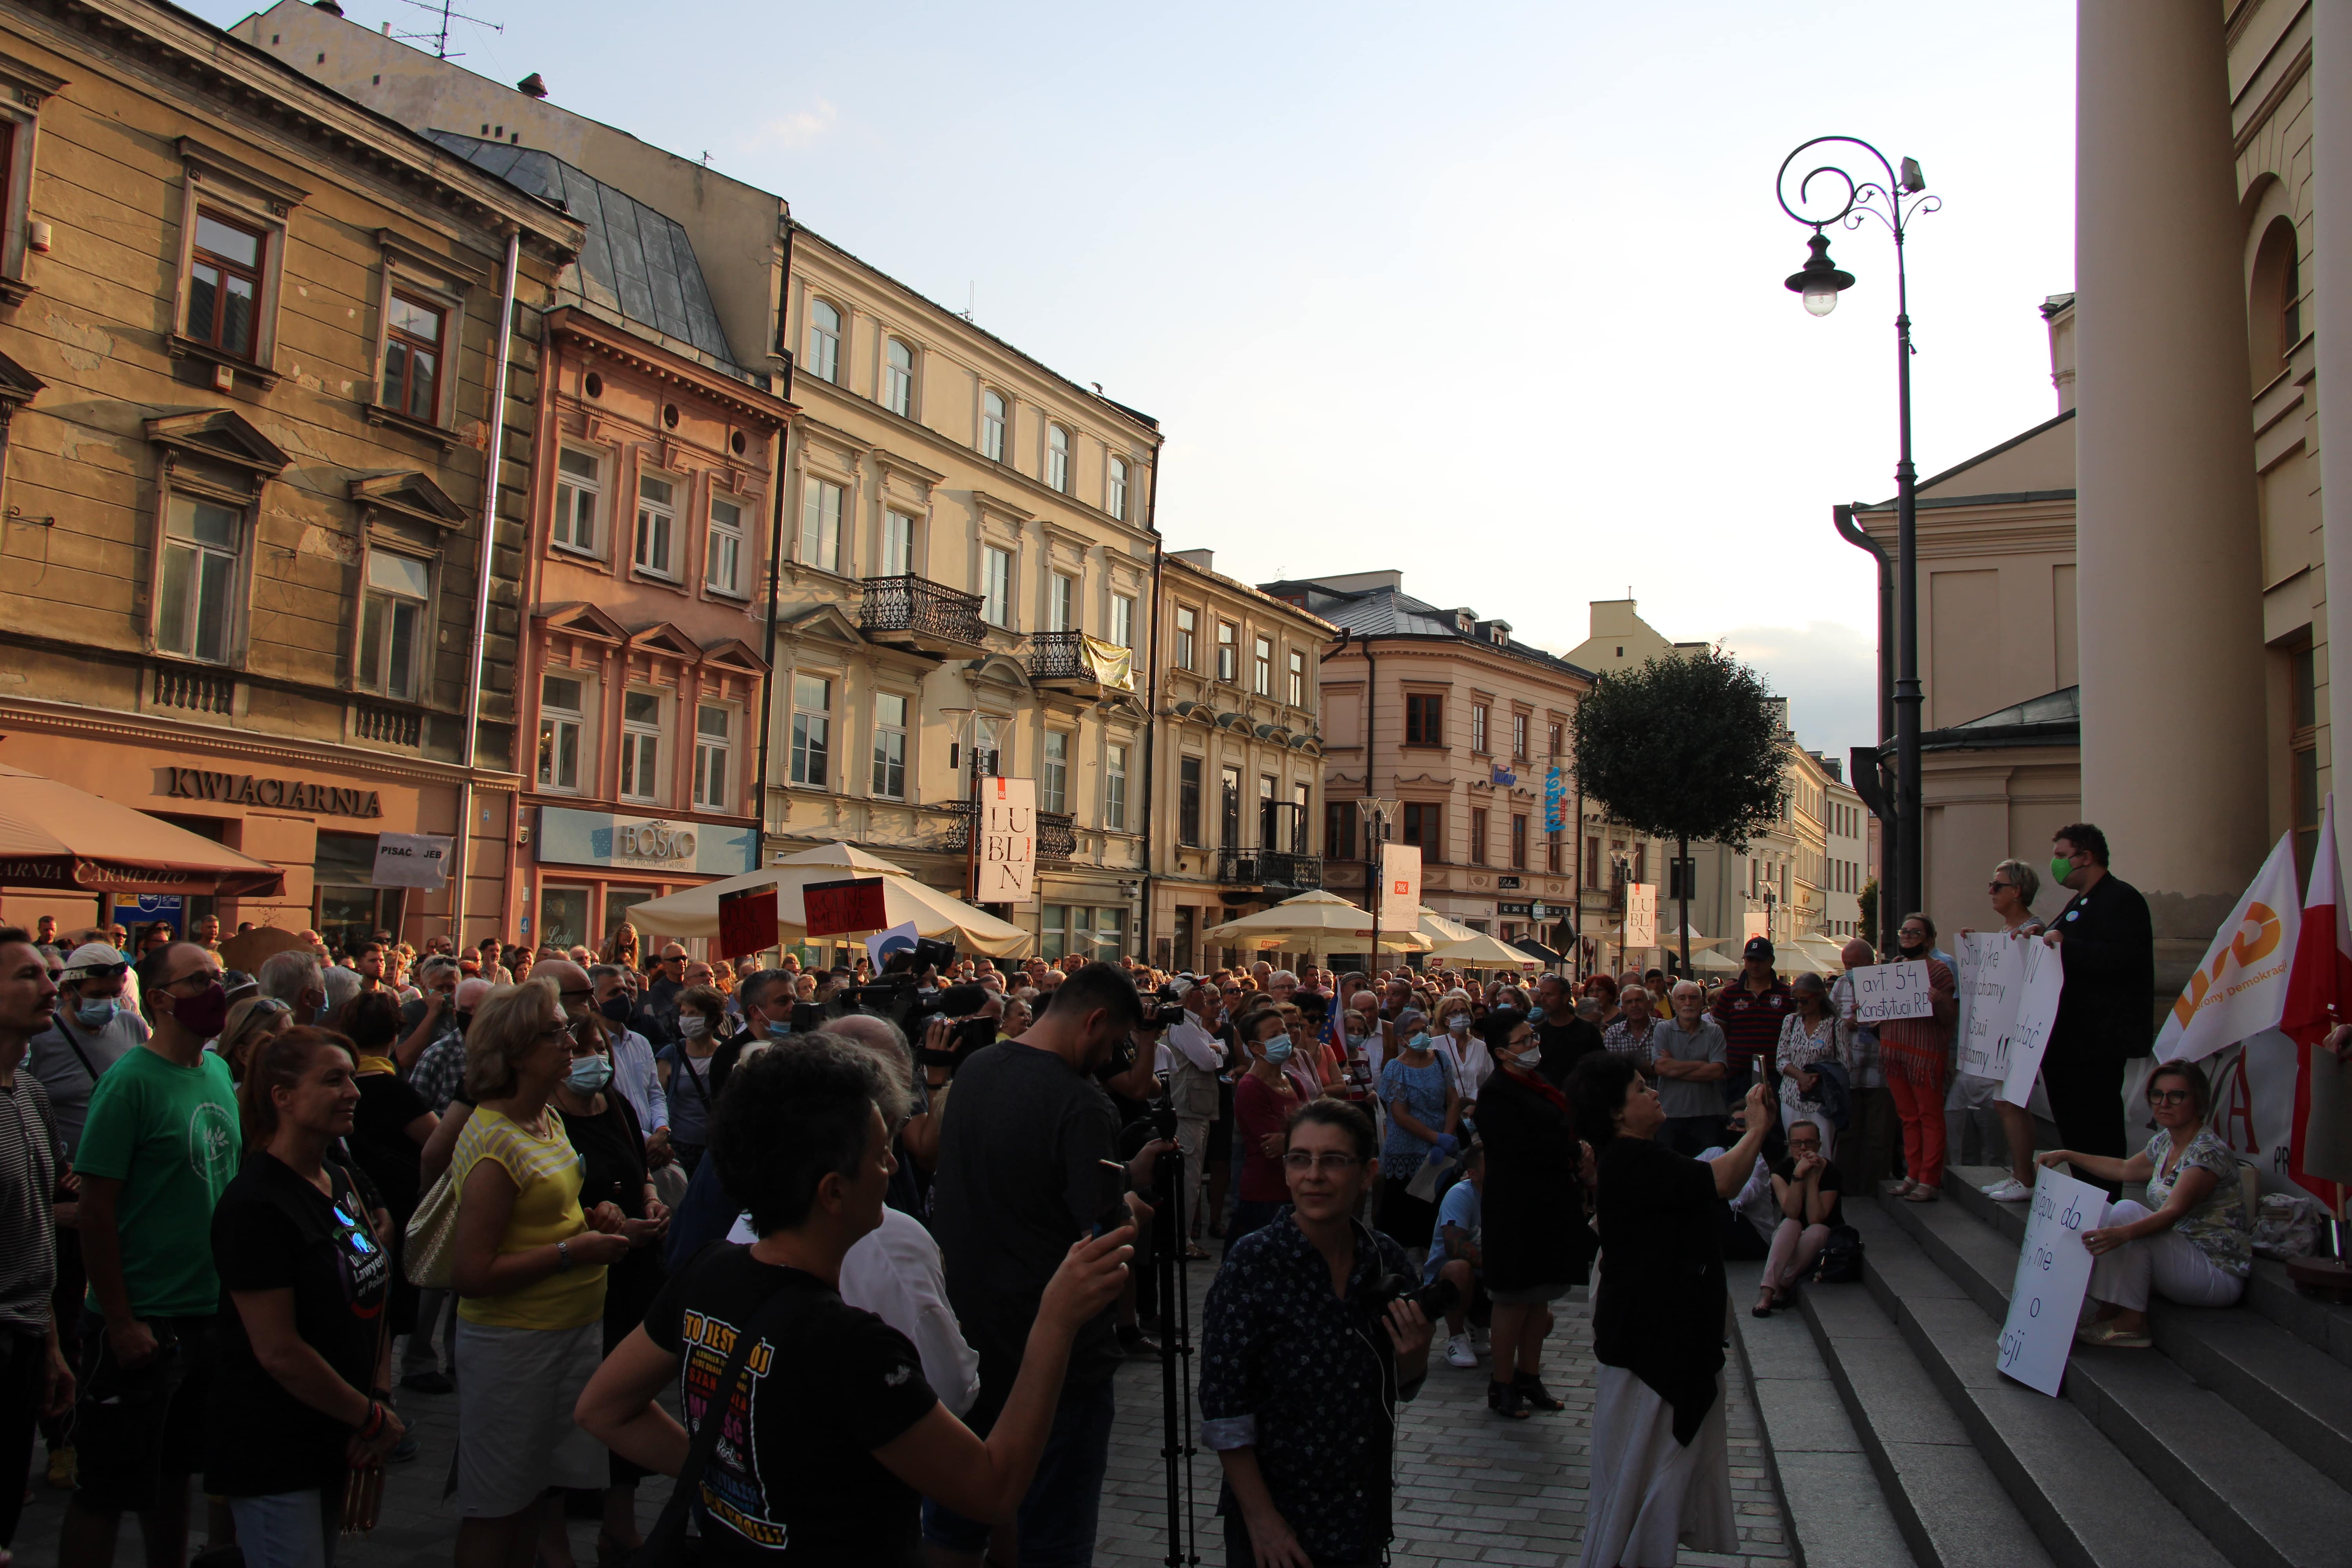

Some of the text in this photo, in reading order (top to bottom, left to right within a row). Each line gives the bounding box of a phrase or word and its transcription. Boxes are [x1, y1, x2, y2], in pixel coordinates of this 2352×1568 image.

[169, 767, 384, 817] KWIACIARNIA
[381, 846, 442, 858] PISAĆ JEB
[621, 857, 634, 865] LODY
[637, 858, 666, 868] PRODUKCJI
[74, 862, 188, 884] CARMELITO
[998, 865, 1026, 889] N
[808, 887, 869, 912] WOLNE
[522, 920, 528, 932] 4
[812, 909, 866, 932] MEDIA
[544, 925, 574, 949] Lody
[723, 924, 763, 956] MEDIA
[1863, 965, 1917, 993] art. 54
[2227, 959, 2287, 996] Demokracji
[1857, 992, 1929, 1019] Konstytucji RP
[2061, 1195, 2081, 1230] do
[2033, 1243, 2053, 1271] nie
[358, 1285, 367, 1297] of
[684, 1314, 769, 1373] TO JEST ÓJ
